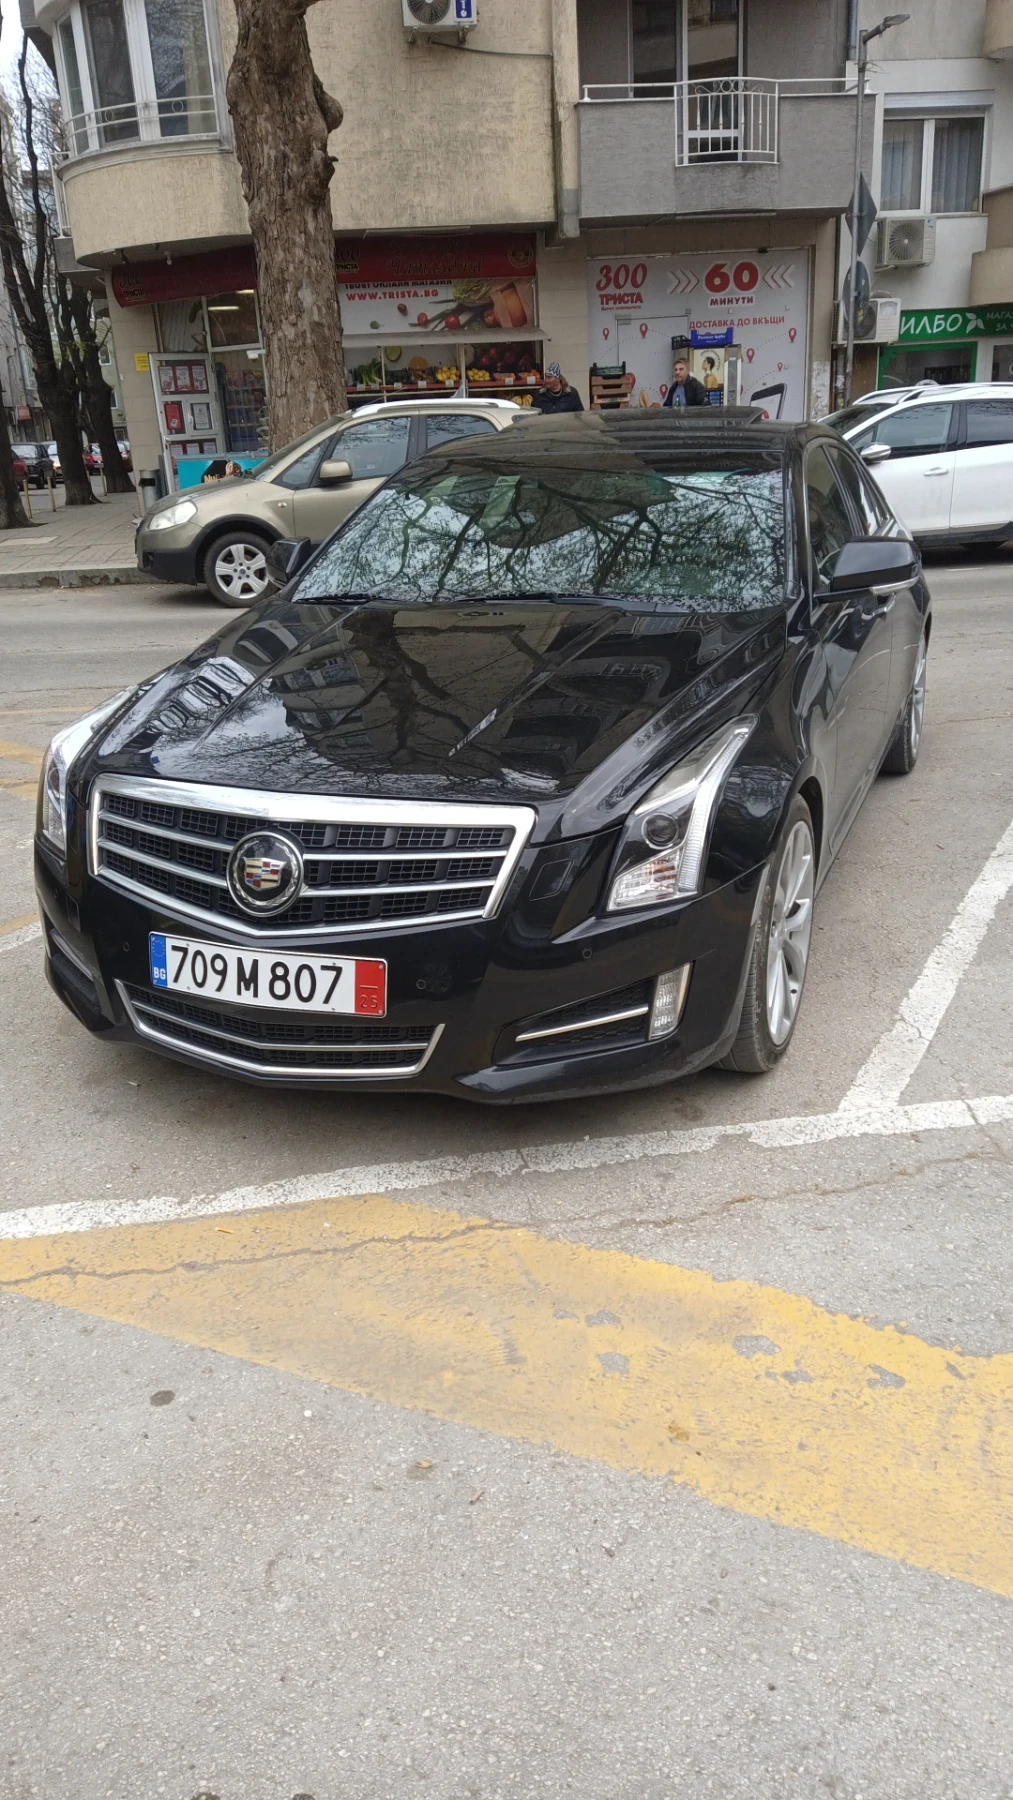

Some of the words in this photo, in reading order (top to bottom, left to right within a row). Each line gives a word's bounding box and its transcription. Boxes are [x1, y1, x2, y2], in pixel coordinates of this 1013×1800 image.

[596, 263, 647, 291] 300
[704, 261, 759, 293] 60
[346, 289, 439, 301] WWW.TRISTA.BG
[599, 292, 643, 305] ТРИСТА
[709, 296, 754, 307] МИНУТИ
[688, 319, 735, 330] ДОСТАВКА
[736, 317, 750, 327] ДО
[752, 315, 785, 325] ВКЪЩИ
[154, 967, 166, 979] BG
[171, 945, 228, 992] 709
[236, 956, 259, 998] M
[268, 961, 343, 1004] 807
[359, 994, 379, 1008] 25
